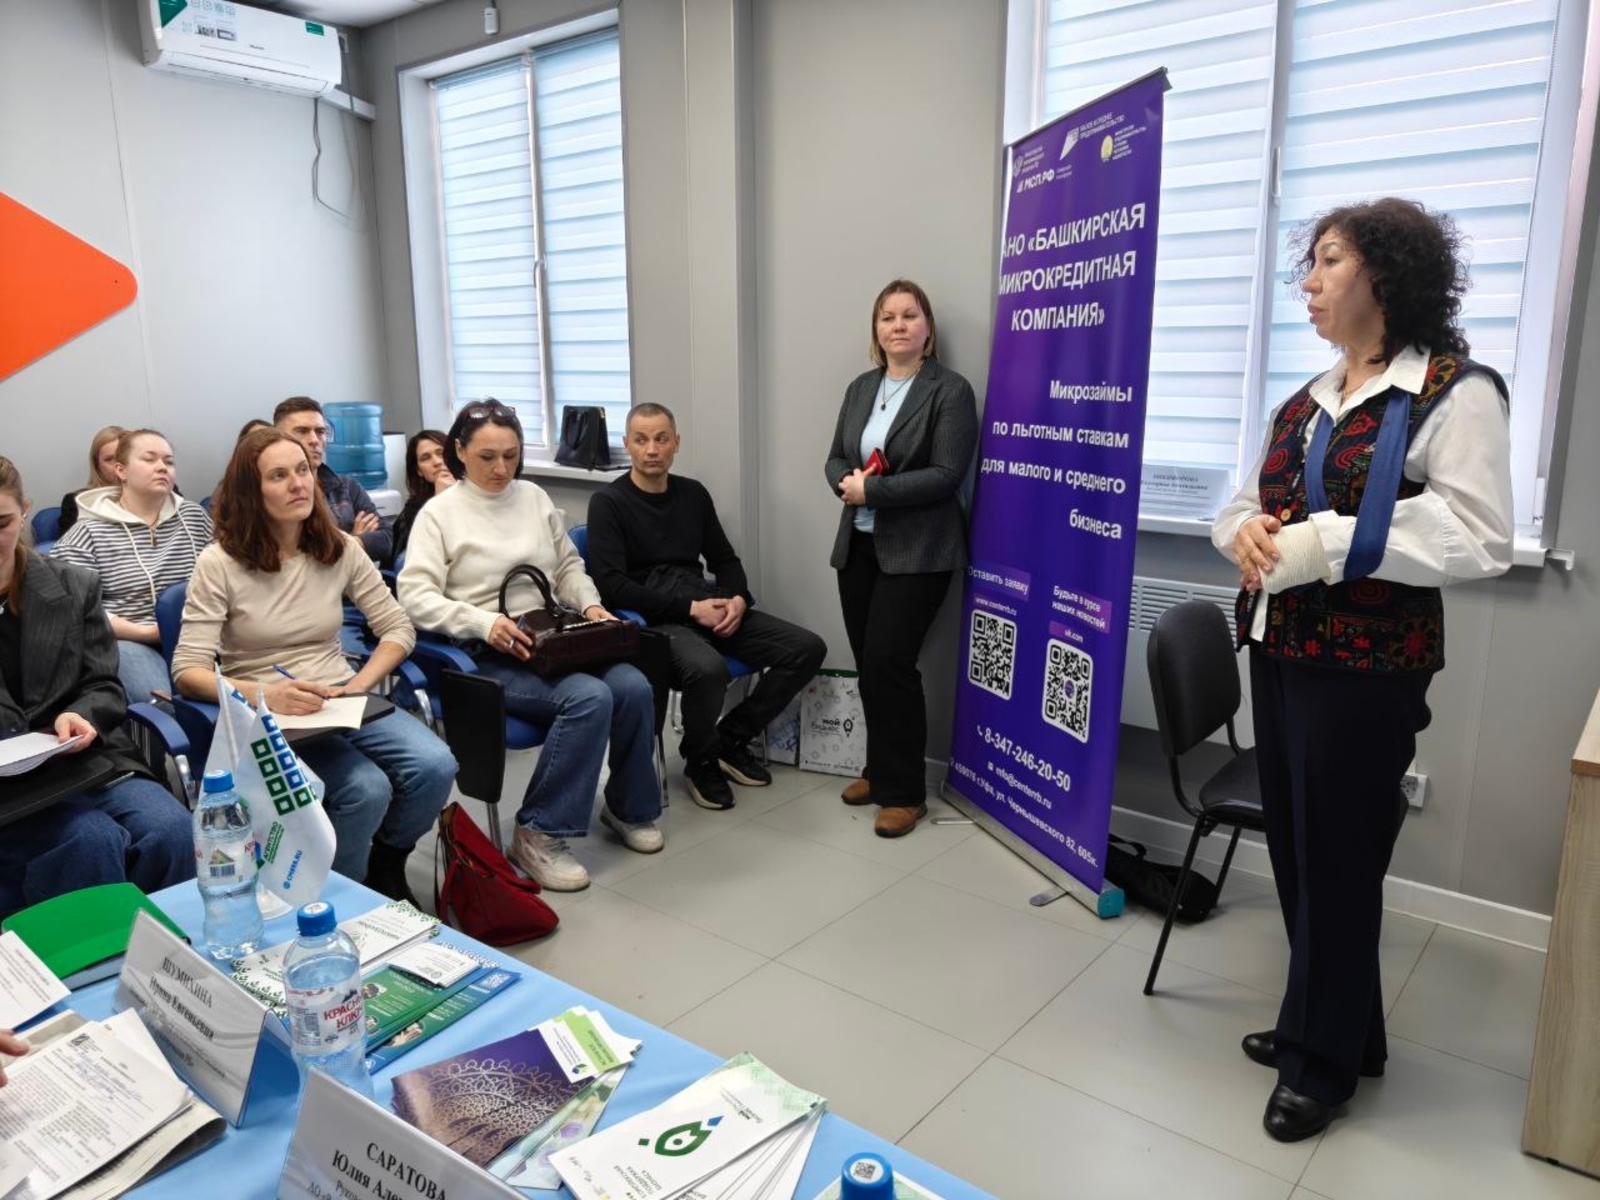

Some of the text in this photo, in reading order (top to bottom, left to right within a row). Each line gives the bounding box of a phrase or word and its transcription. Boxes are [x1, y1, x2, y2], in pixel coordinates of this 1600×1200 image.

[1028, 203, 1146, 251] «БАШКИРСКАЯ
[1011, 302, 1105, 331] КОМПАНИЯ»
[1050, 380, 1132, 404] Микрозаймы
[992, 421, 1129, 448] по льготным ставкам
[981, 458, 1005, 474] для
[1008, 461, 1051, 481] малого
[1053, 468, 1062, 482] и
[1065, 469, 1126, 494] среднего
[1069, 508, 1123, 539] бизнеса
[968, 565, 1029, 595] Оставить заявку
[1053, 585, 1078, 602] Будьте
[1076, 609, 1105, 629] новостей
[984, 727, 1071, 792] 8-347-246-20-50
[263, 820, 279, 859] АГЕНТСТВО
[162, 956, 213, 1008] ШУМИХИНА
[172, 996, 215, 1041] Евгеньевна
[332, 1149, 403, 1200] Юлия Але
[366, 1142, 446, 1200] САРАТОВА
